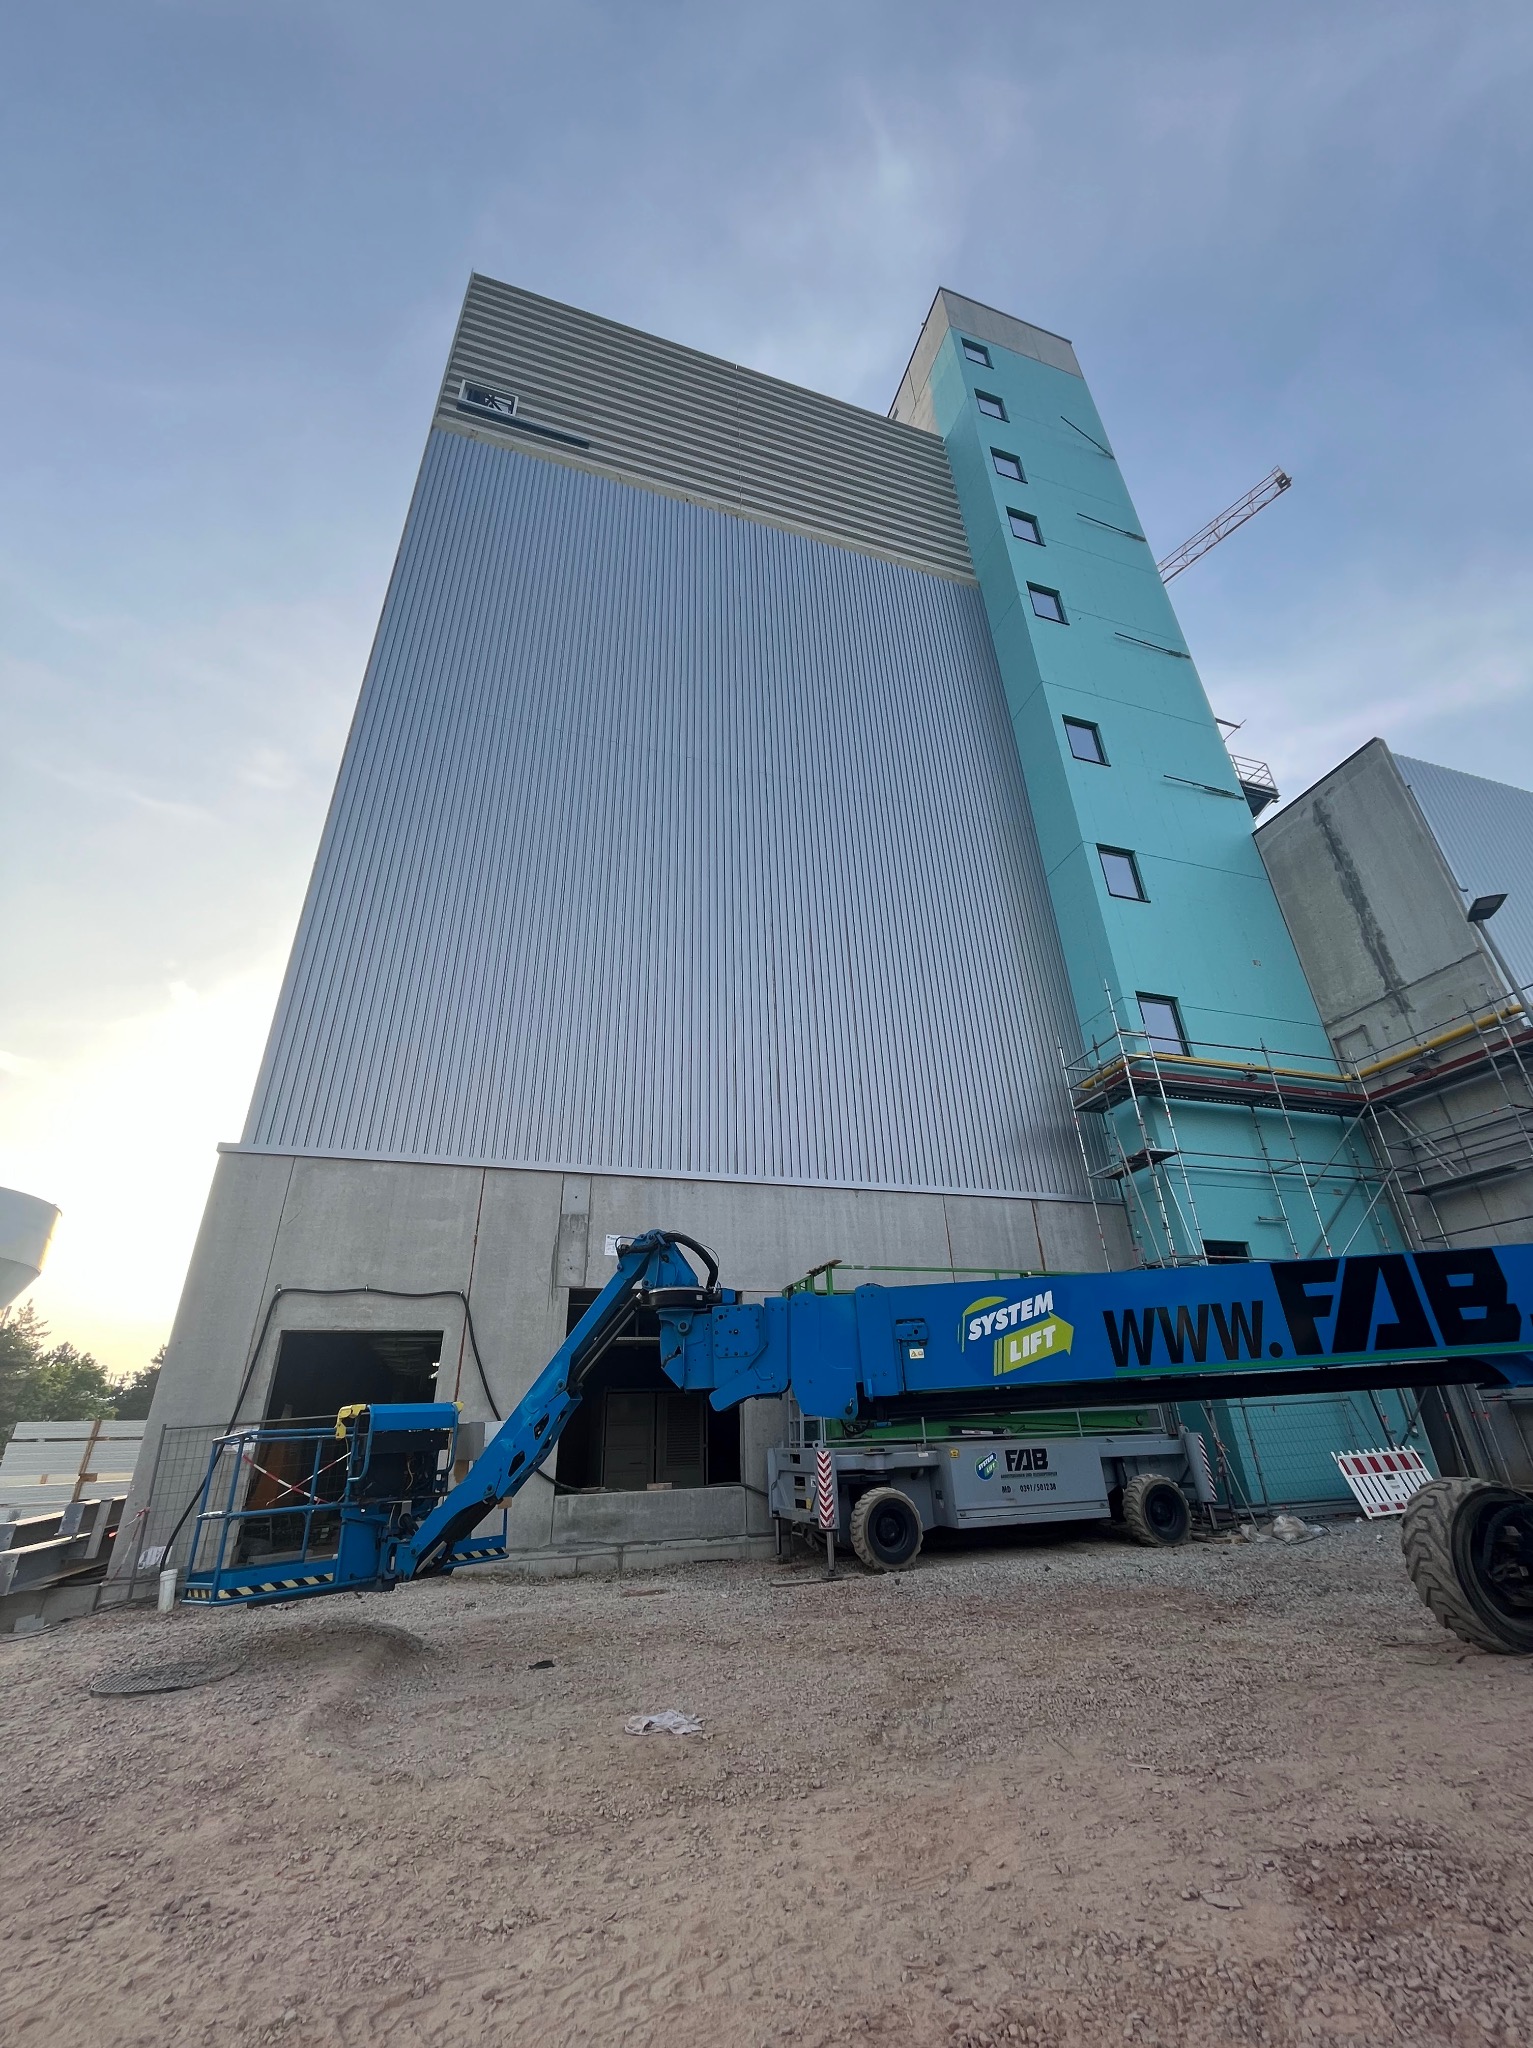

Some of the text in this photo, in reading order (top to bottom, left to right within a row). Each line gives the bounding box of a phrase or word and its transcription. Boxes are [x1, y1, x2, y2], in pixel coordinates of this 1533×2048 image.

[968, 1290, 1053, 1341] SYSTEM
[1103, 1247, 1533, 1368] WWW.FAB
[1010, 1324, 1056, 1363] LIFT
[978, 1454, 994, 1471] SYSTEM
[1005, 1448, 1049, 1471] FAB
